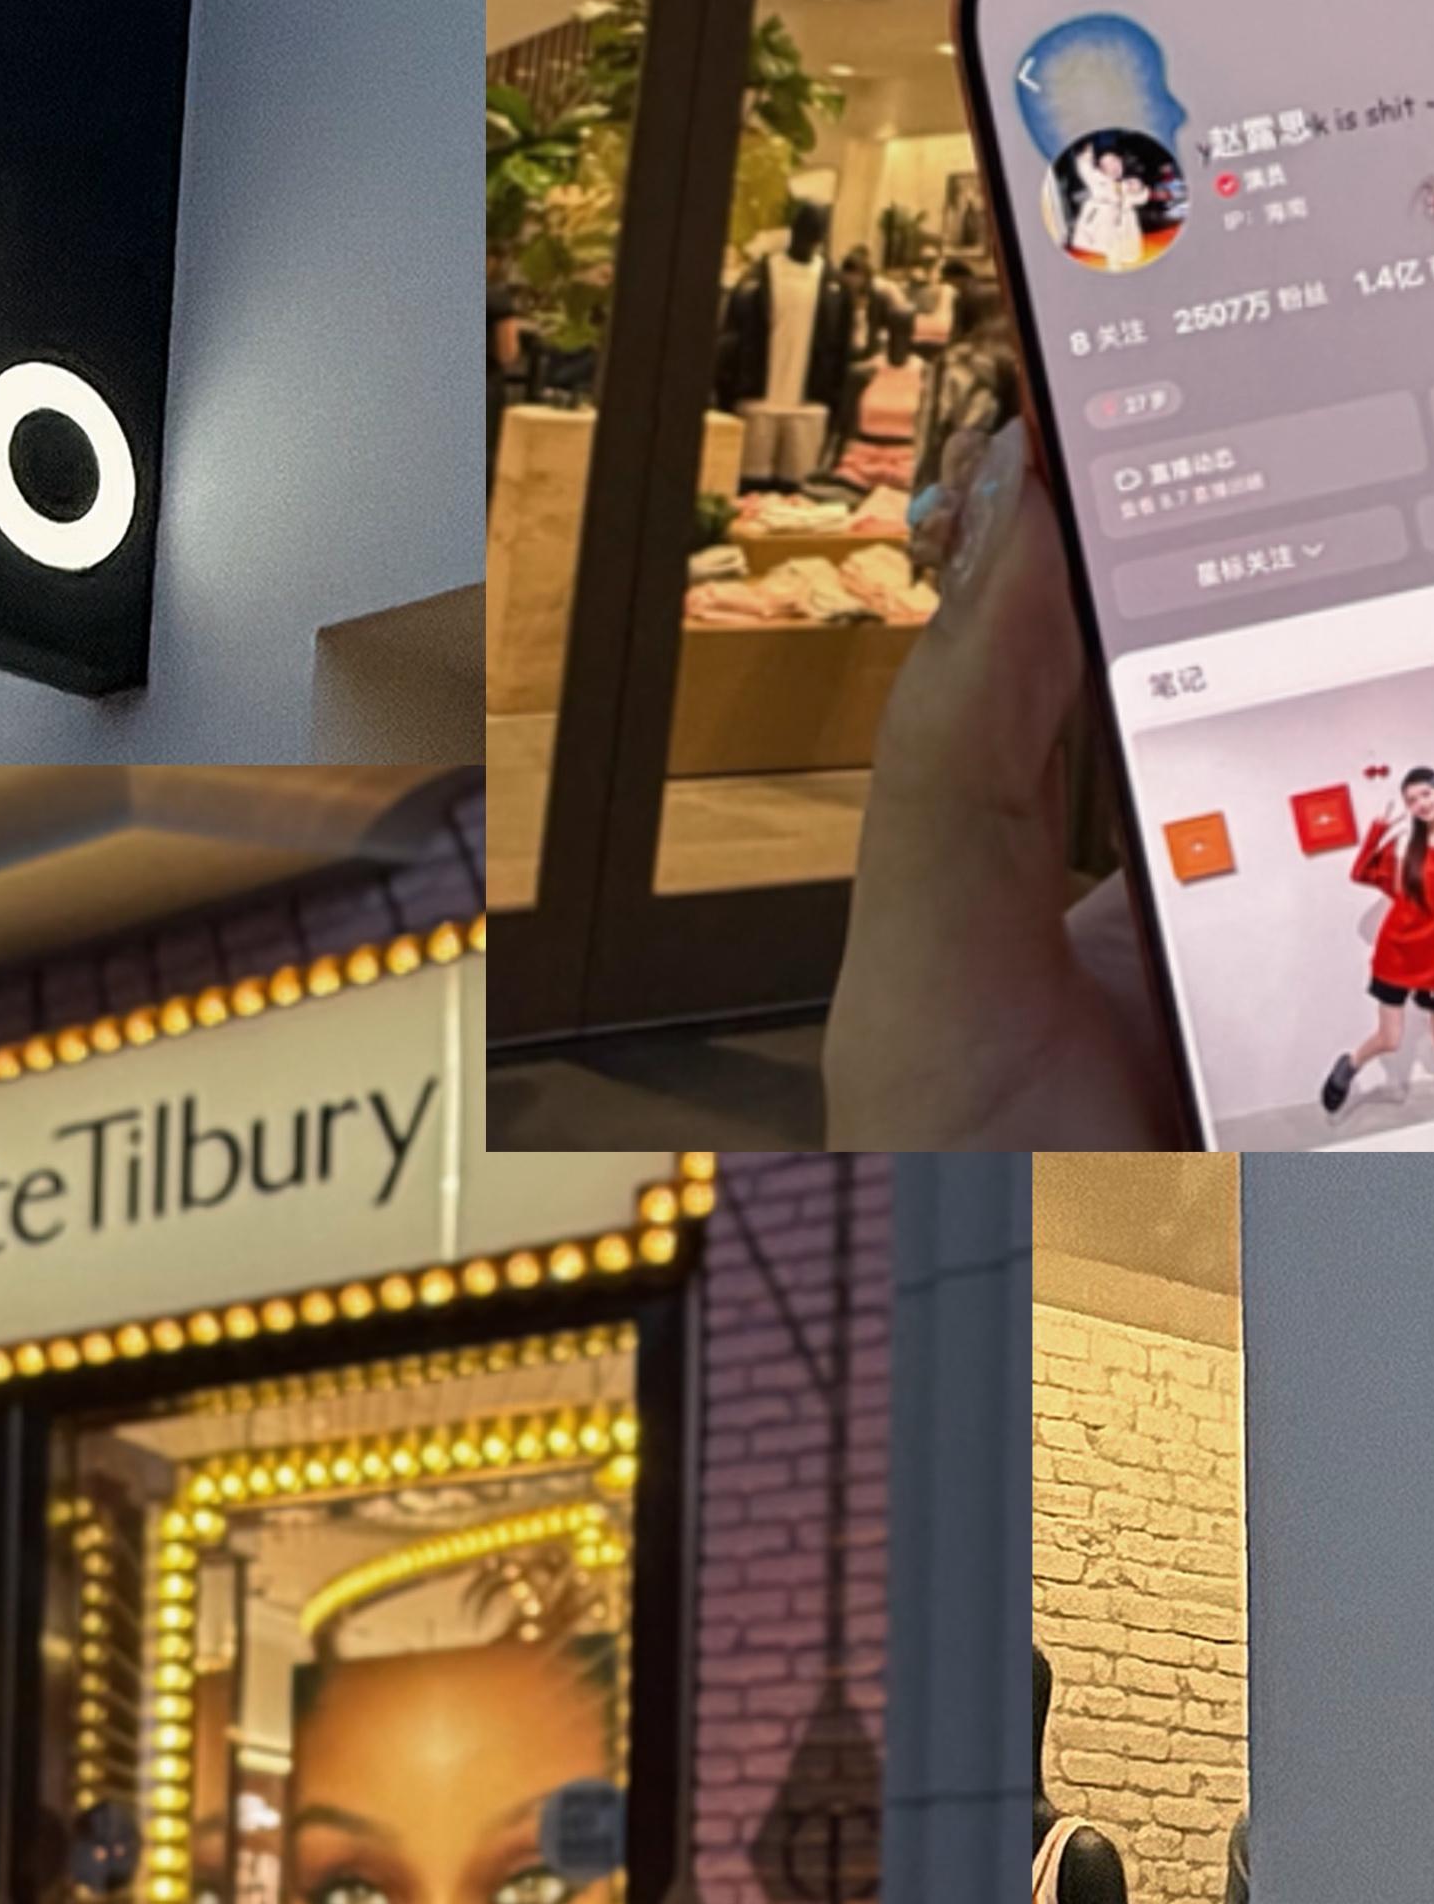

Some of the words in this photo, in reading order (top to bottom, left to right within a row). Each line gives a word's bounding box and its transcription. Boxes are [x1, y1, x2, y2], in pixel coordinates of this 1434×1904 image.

[1335, 105, 1358, 130] is
[1367, 97, 1415, 129] shit
[1069, 331, 1091, 357] 8
[1096, 320, 1148, 352] 关注
[1173, 291, 1271, 336] 2507万
[1278, 282, 1328, 313] 粉丝
[1353, 258, 1425, 297] 1.4亿
[1197, 543, 1295, 588] 星标关注
[1148, 664, 1208, 700] 笔记
